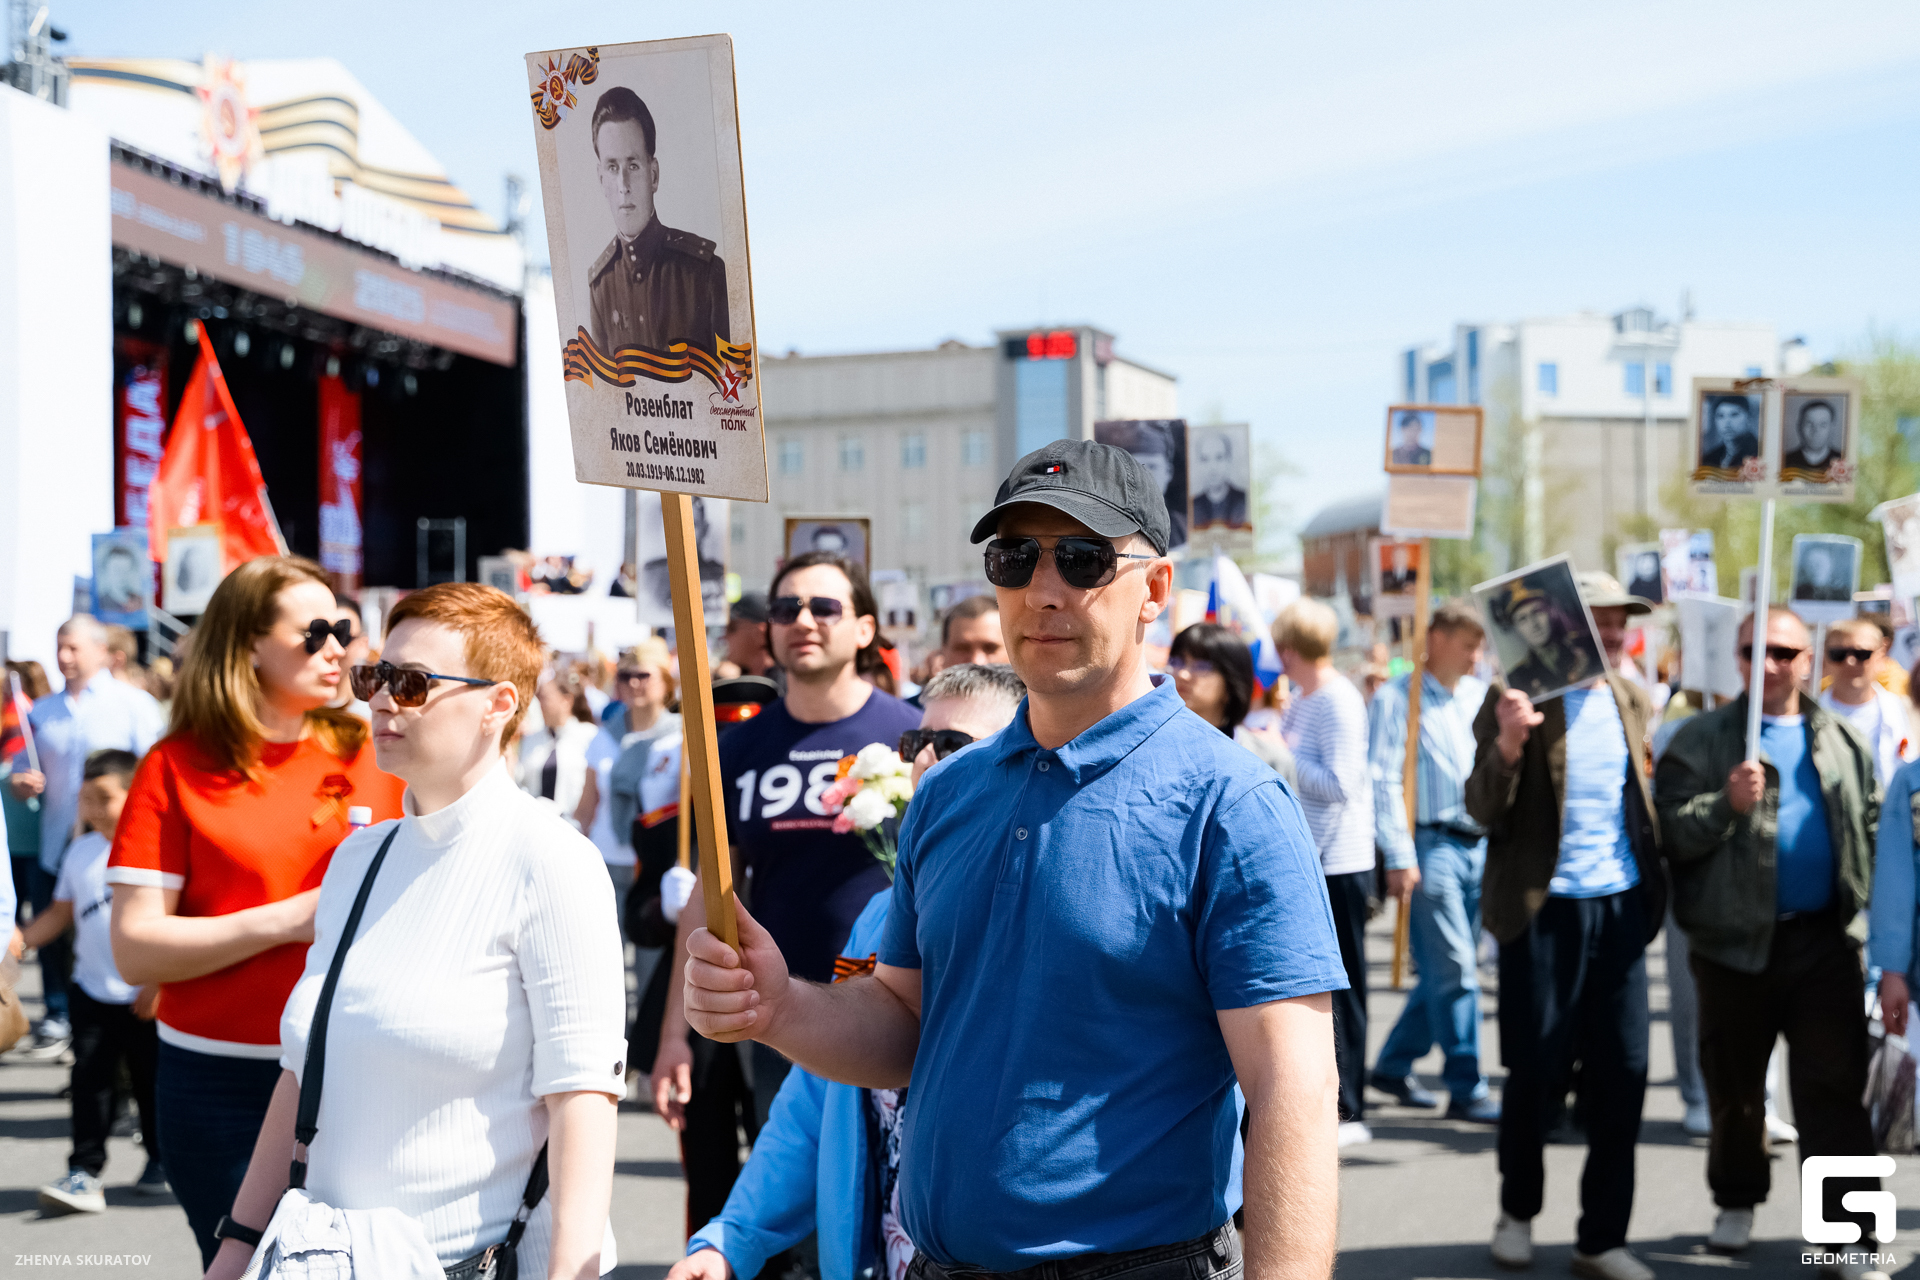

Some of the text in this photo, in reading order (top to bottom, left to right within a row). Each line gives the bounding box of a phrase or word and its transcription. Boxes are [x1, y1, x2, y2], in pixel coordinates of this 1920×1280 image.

[625, 391, 694, 420] Розенблат
[709, 396, 758, 418] бессмертный
[721, 418, 747, 431] ПОЛК
[610, 427, 718, 460] Яков Семёнович
[625, 461, 706, 485] 20.03.1919-06.12.1982
[735, 761, 844, 822] 198
